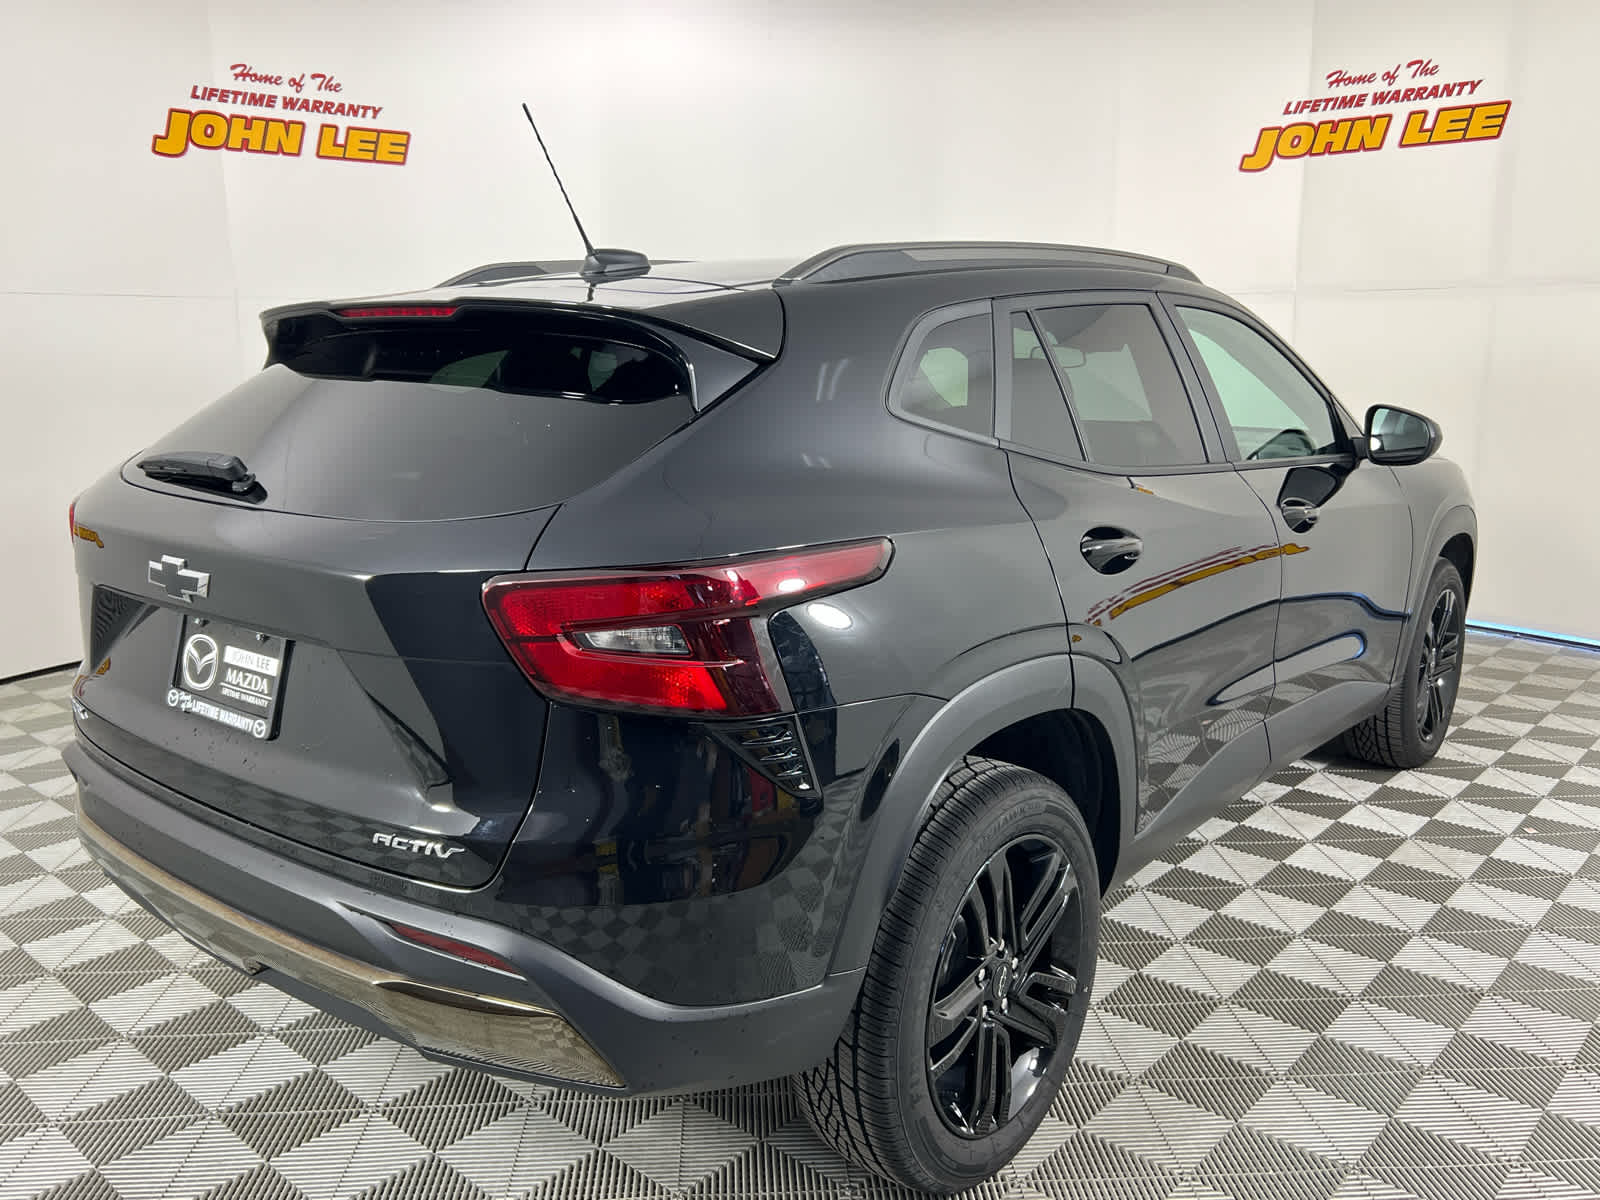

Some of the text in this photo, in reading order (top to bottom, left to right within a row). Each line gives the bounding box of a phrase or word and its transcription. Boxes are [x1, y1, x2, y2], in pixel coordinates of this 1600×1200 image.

[230, 64, 343, 93] Home of The
[1326, 59, 1440, 89] Home of The
[190, 85, 383, 119] LIFETIME WARRANTY
[1283, 79, 1483, 116] LIFETIME WARRANTY
[152, 108, 411, 166] JOHN LEE
[1239, 100, 1512, 173] JOHN LEE
[256, 655, 272, 671] LEE
[226, 667, 269, 694] MAZDA
[192, 699, 220, 720] LIFETIME
[220, 708, 254, 733] WARRANTY
[372, 832, 465, 859] ACTIV
